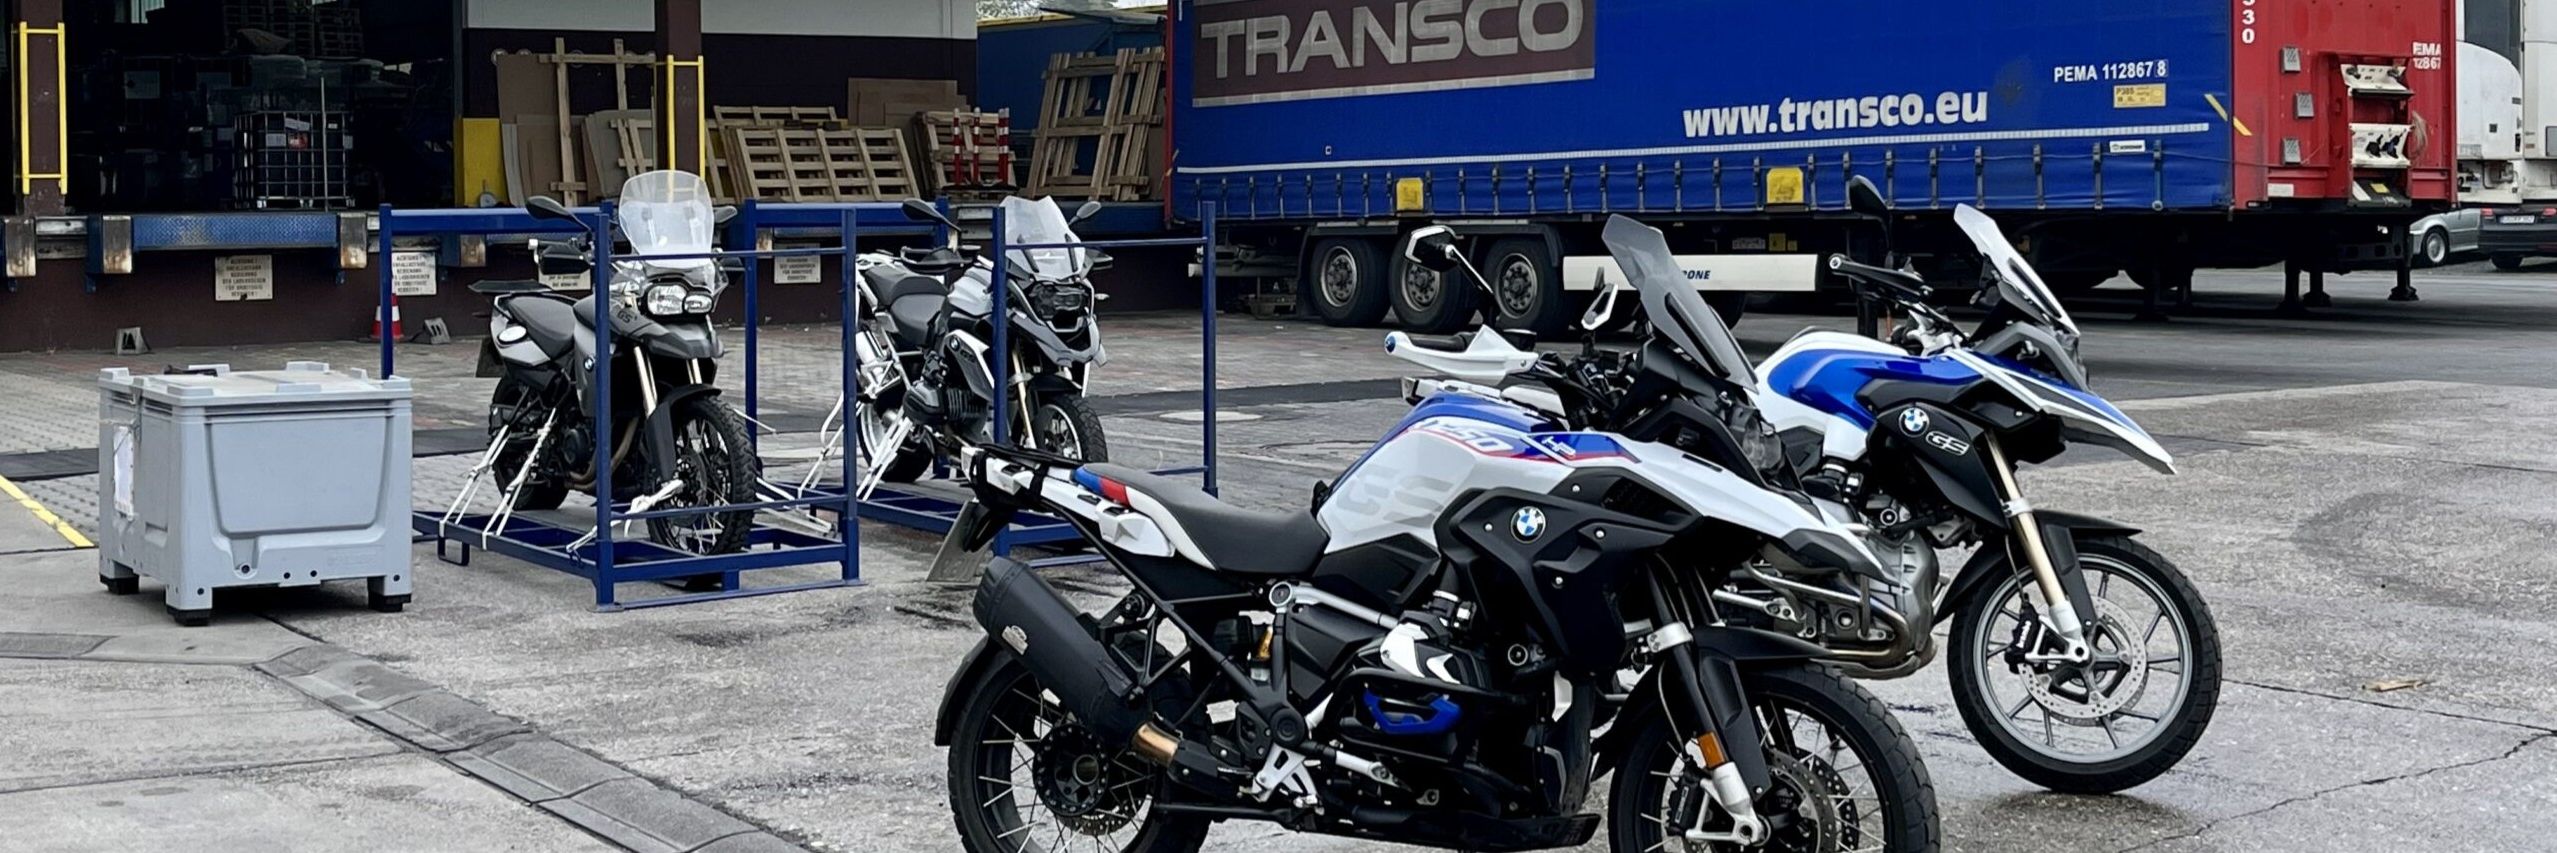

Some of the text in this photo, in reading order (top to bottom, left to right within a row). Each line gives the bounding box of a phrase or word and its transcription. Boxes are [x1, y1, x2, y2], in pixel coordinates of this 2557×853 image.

[1200, 0, 1584, 79] TRANSCO
[2053, 60, 2167, 82] PEMA 112867 8
[1682, 90, 1988, 138] www.transco.eu
[1682, 269, 1711, 280] ONE
[1925, 430, 1970, 456] GS
